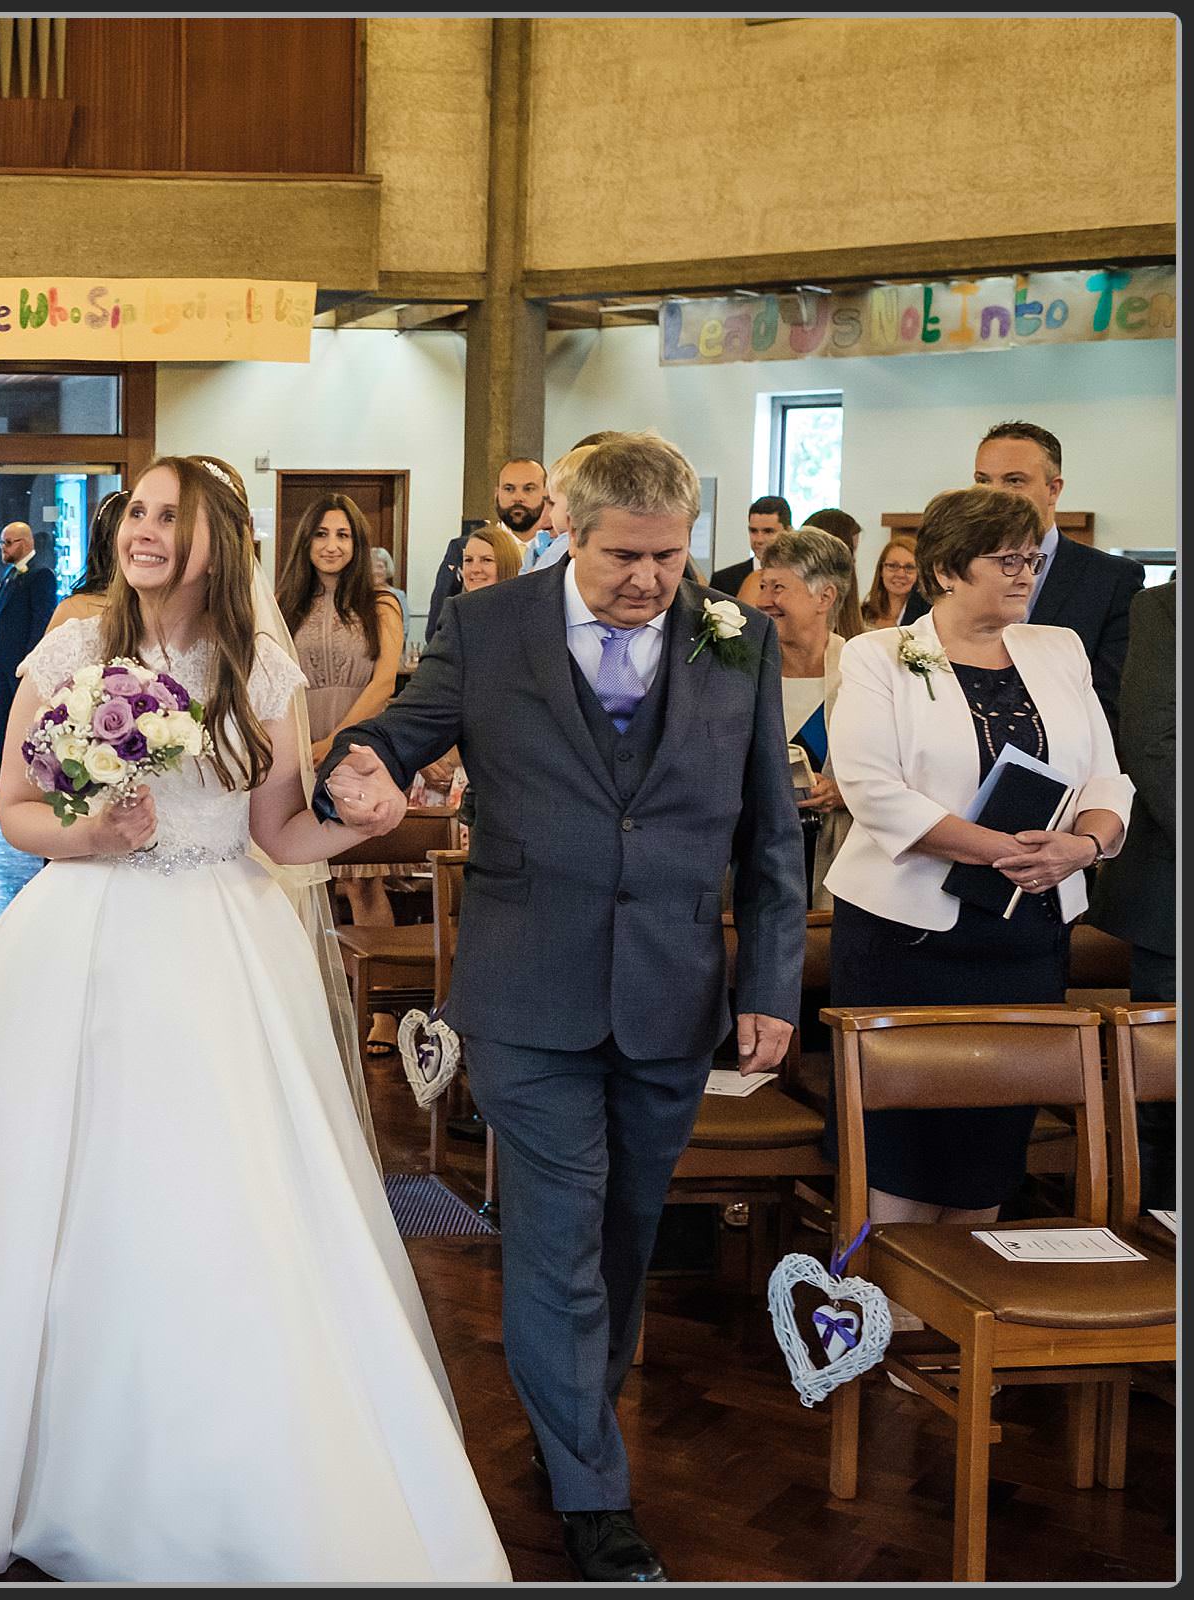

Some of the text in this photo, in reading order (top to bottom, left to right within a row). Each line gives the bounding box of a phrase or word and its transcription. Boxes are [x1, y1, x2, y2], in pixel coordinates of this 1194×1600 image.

[19, 287, 81, 330] Who
[85, 286, 136, 330] Sin
[663, 294, 779, 360] Lead
[782, 293, 862, 353] Us
[870, 286, 941, 345] Not
[949, 275, 1069, 343] Into
